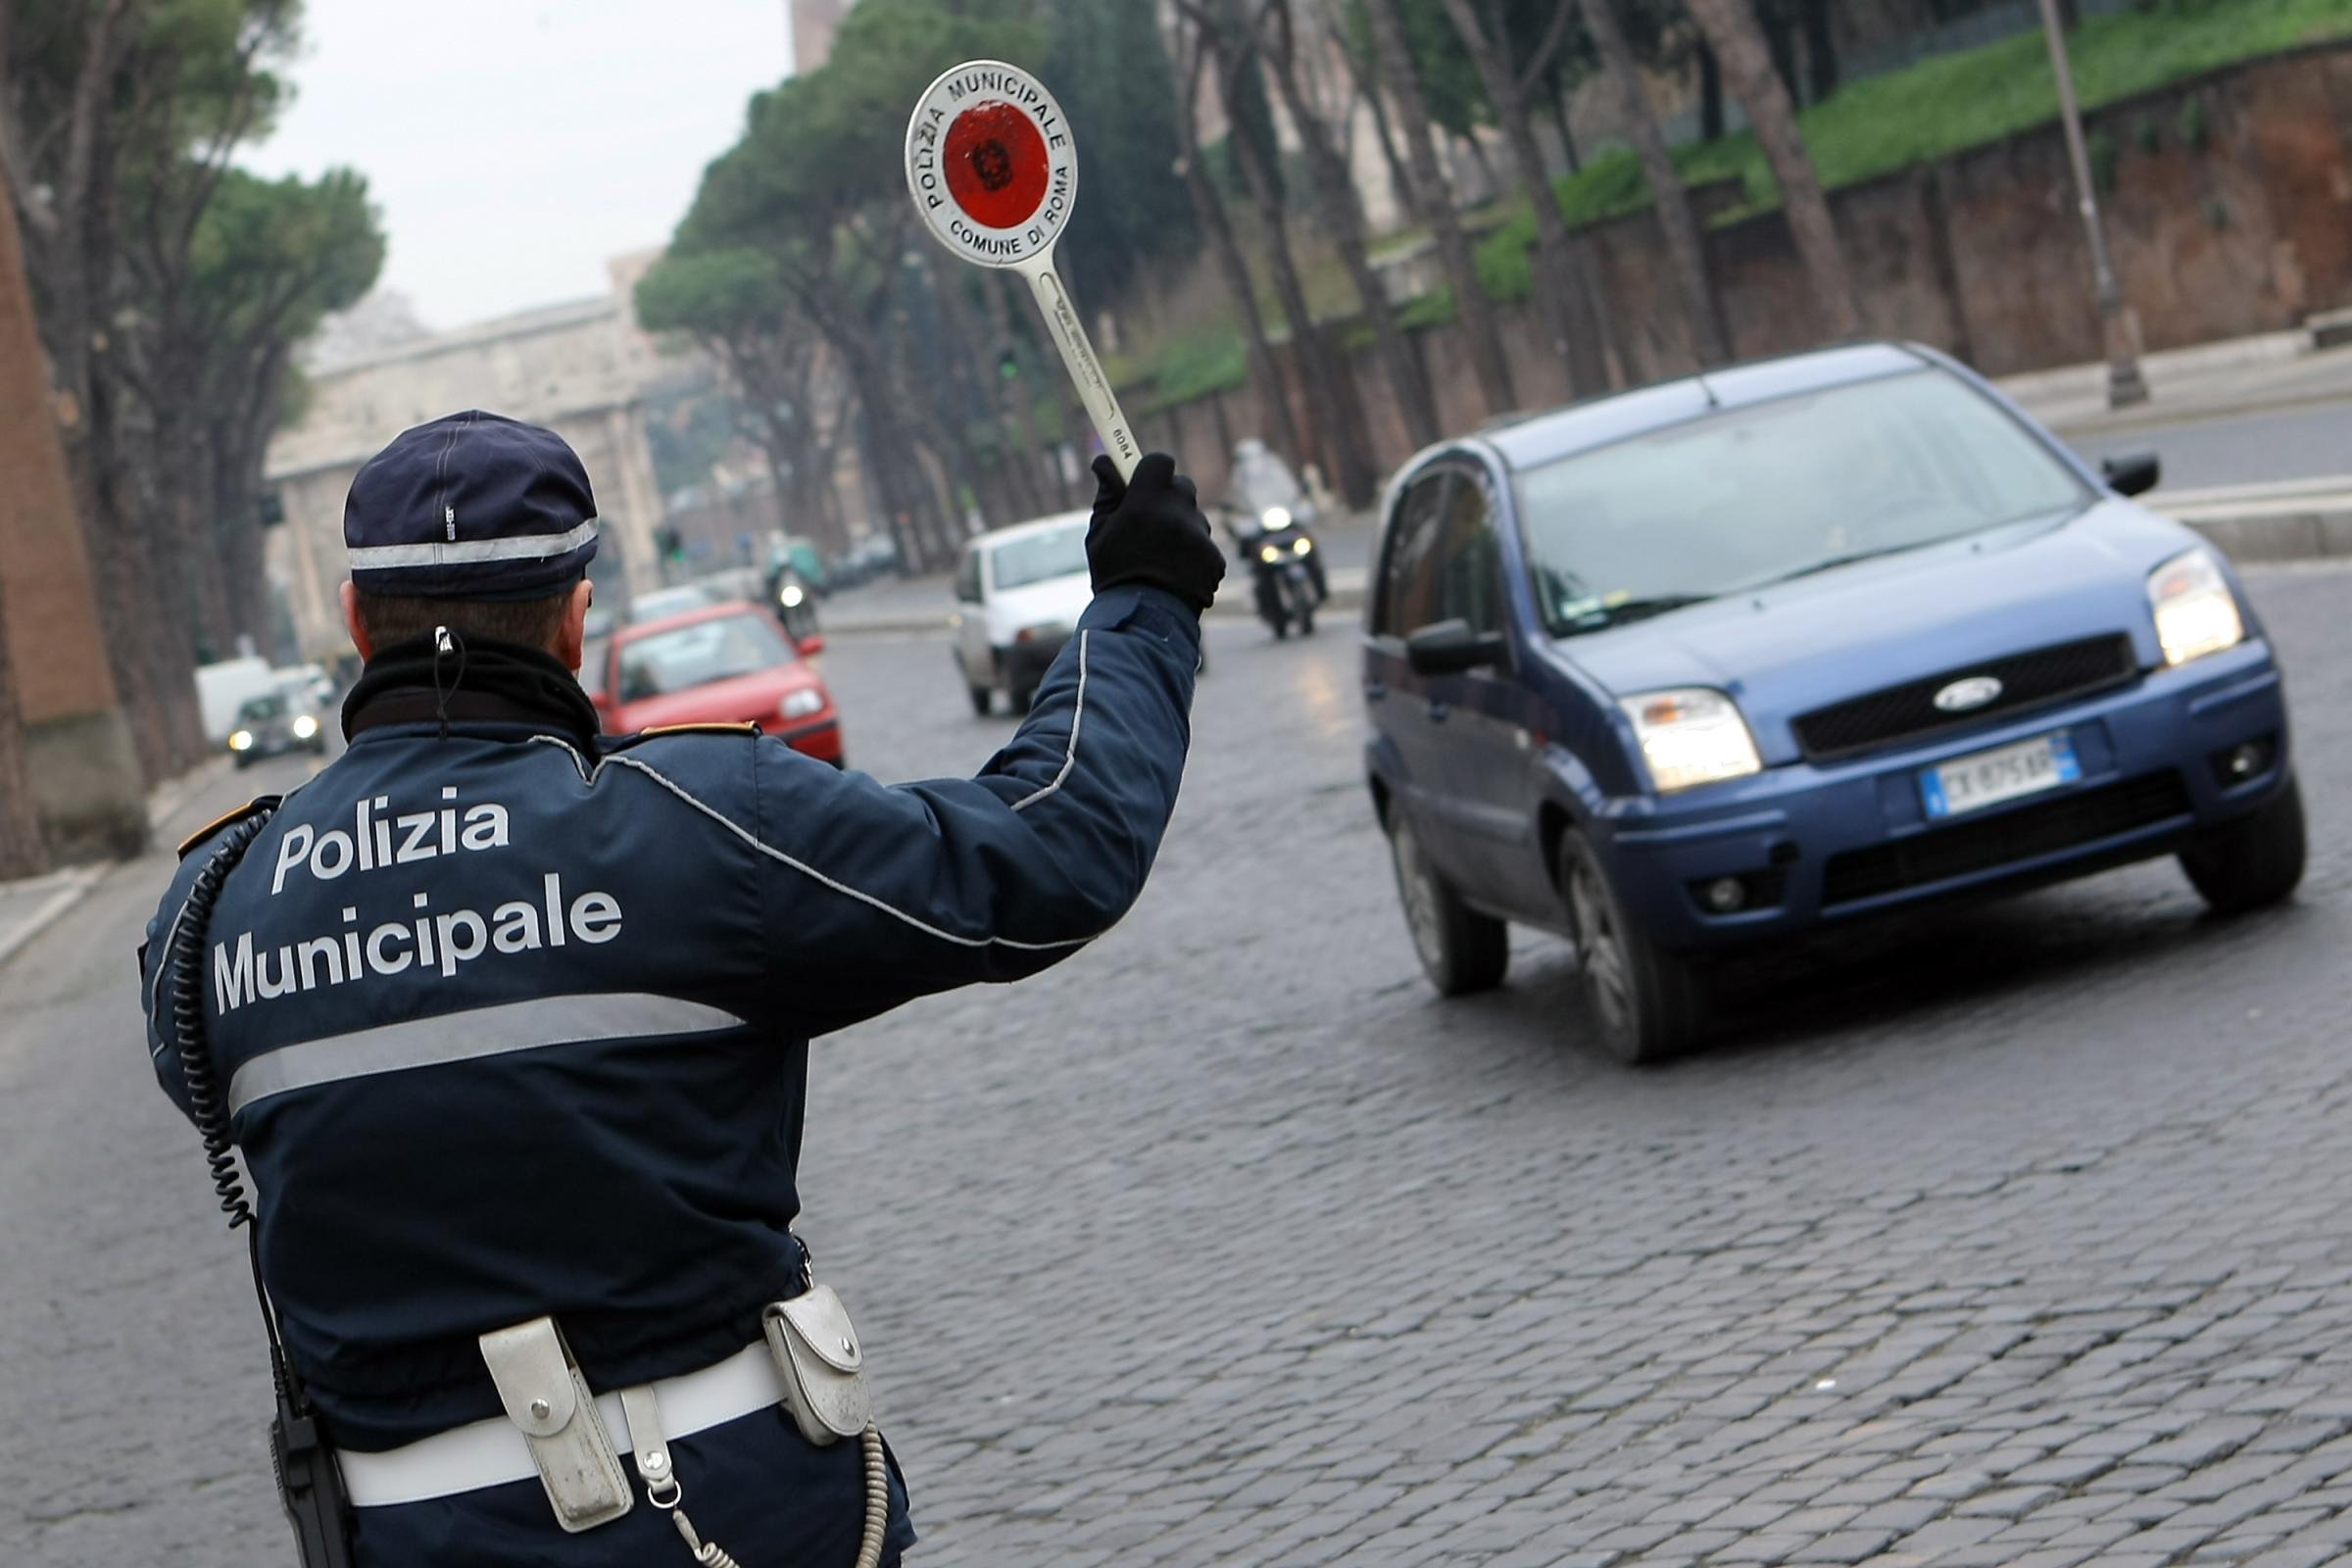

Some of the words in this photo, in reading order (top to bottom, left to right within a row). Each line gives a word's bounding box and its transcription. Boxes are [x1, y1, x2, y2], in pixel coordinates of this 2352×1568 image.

[917, 108, 945, 210] POLIZIA
[948, 72, 1067, 150] MUNICIPALE
[951, 220, 1023, 255] COMUNE
[1027, 224, 1046, 246] DI
[1045, 166, 1068, 225] ROMA
[271, 787, 511, 895] Polizia
[213, 872, 623, 1016] Municipale
